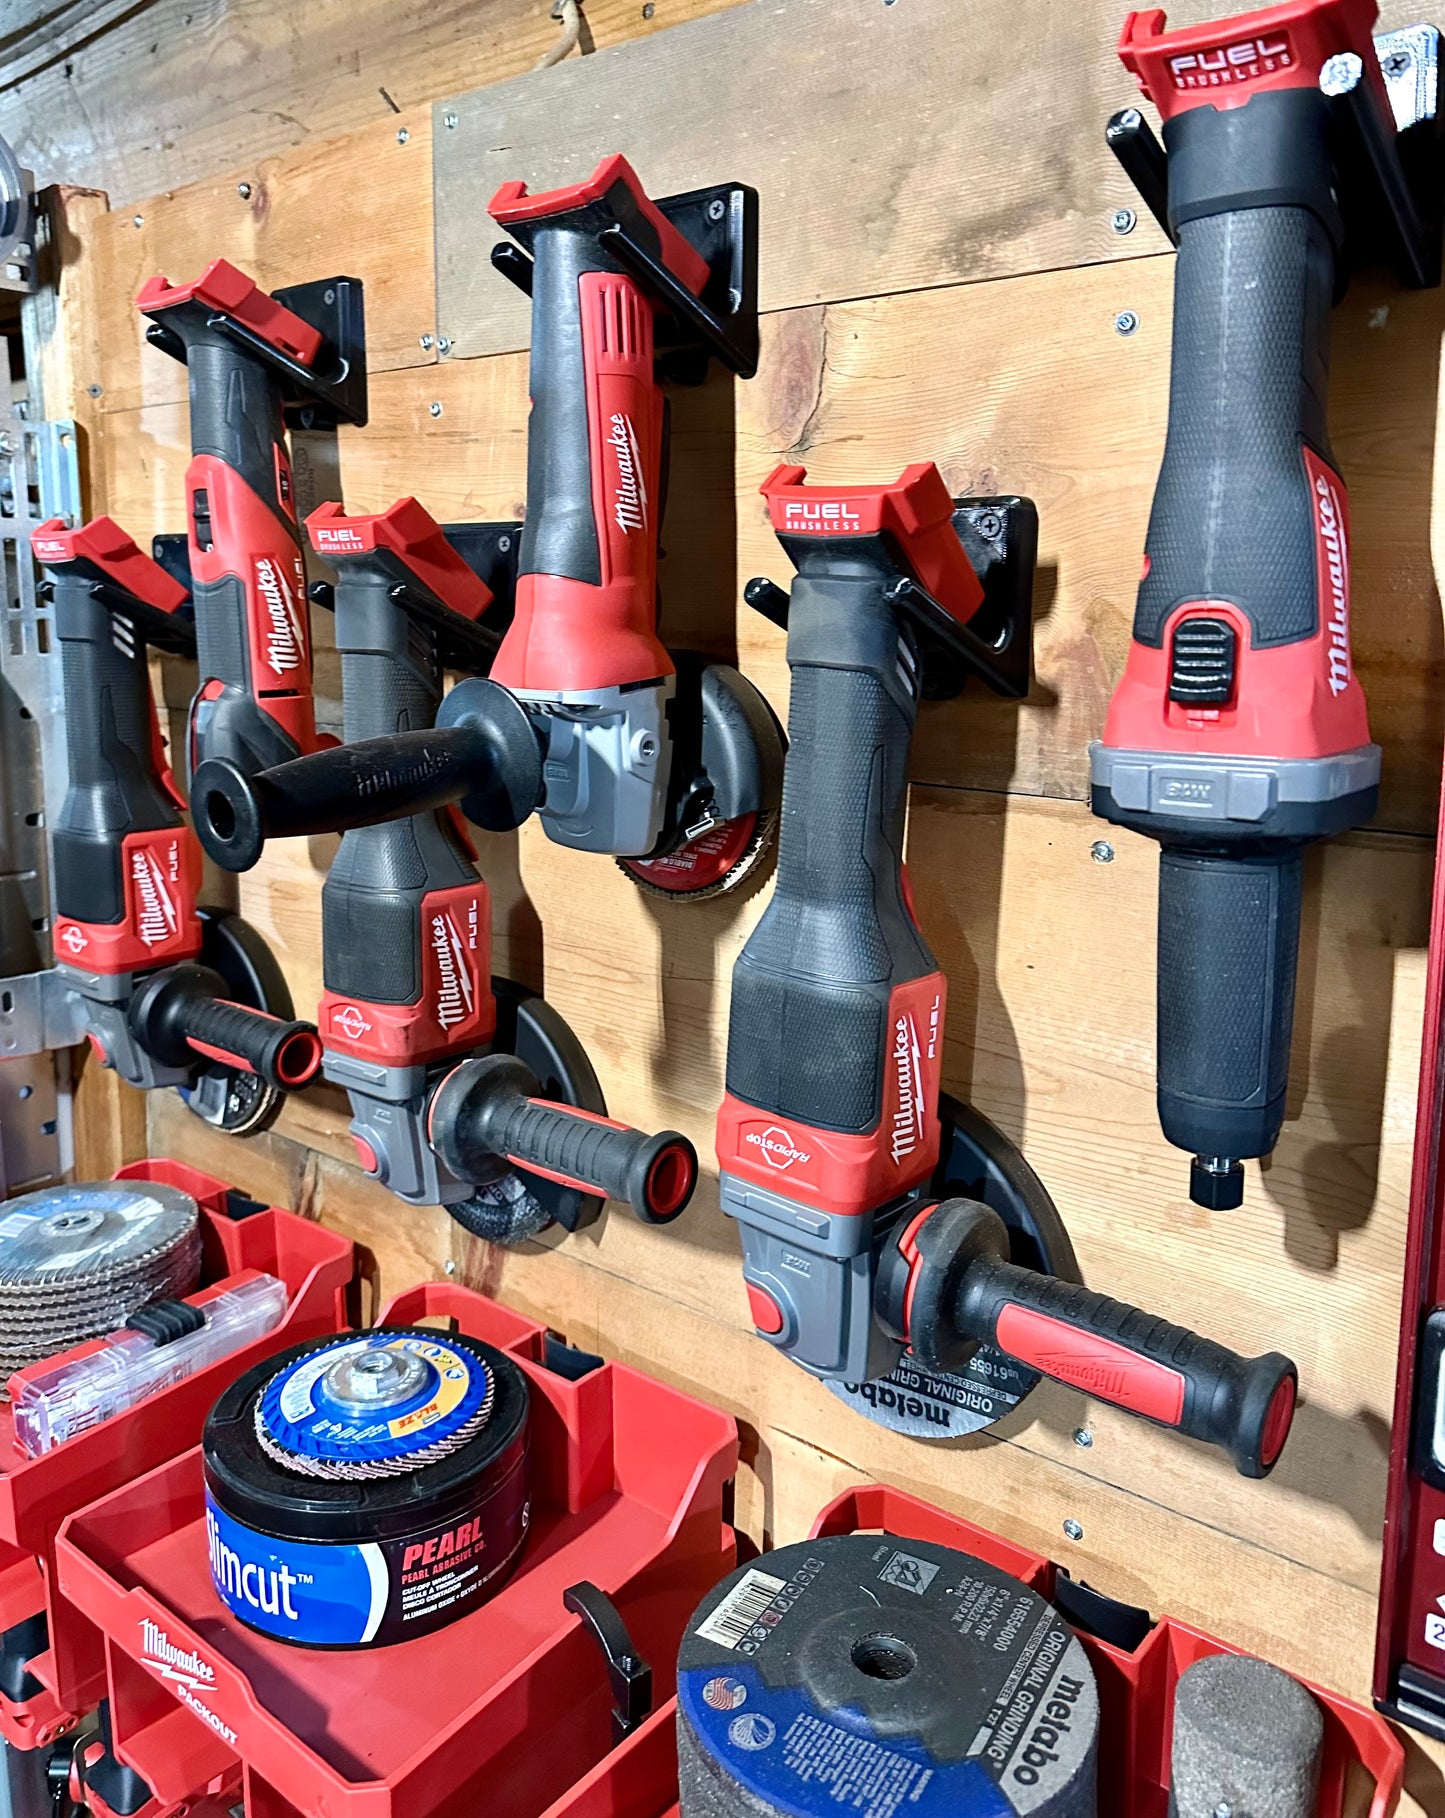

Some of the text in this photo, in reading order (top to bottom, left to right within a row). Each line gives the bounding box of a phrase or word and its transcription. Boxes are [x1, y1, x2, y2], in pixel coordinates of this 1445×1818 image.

[1170, 39, 1287, 75] FUEL
[1175, 53, 1291, 88] BRUSHLESS
[606, 412, 643, 535] Milwaukee
[317, 529, 362, 543] FUEL
[785, 503, 860, 519] FUEL
[785, 520, 860, 531] BRUSHLESS
[1316, 474, 1348, 697] Milwaukee
[256, 558, 300, 676] Milwaukee
[168, 839, 179, 882] FUEL
[131, 851, 169, 948] Milwaukee
[468, 899, 478, 950] FUEL
[431, 914, 466, 1031] Milwaukee
[928, 995, 941, 1059] FUEL
[891, 1015, 917, 1166] Milwaukee
[745, 1132, 812, 1164] RAPIDSTOP
[398, 1402, 438, 1429] BLAZE
[843, 1382, 951, 1429] metabo
[924, 1378, 993, 1413] ORIGINAL
[401, 1540, 487, 1585] PEARL ABRASIVE CO.
[402, 1516, 483, 1571] PEARL
[402, 1571, 456, 1596] CUT-OFF WHEEL
[402, 1582, 462, 1610] DISCO CORTADOR
[402, 1590, 428, 1603] MEULE
[138, 1617, 216, 1682] Milwaukee
[992, 1596, 1034, 1652] 616554000
[986, 1614, 1052, 1726] DEPRESSED CENTER WHEEL T27
[1023, 1630, 1066, 1689] ORIGINAL
[177, 1683, 238, 1745] PACKOUT
[1013, 1674, 1085, 1786] metabo
